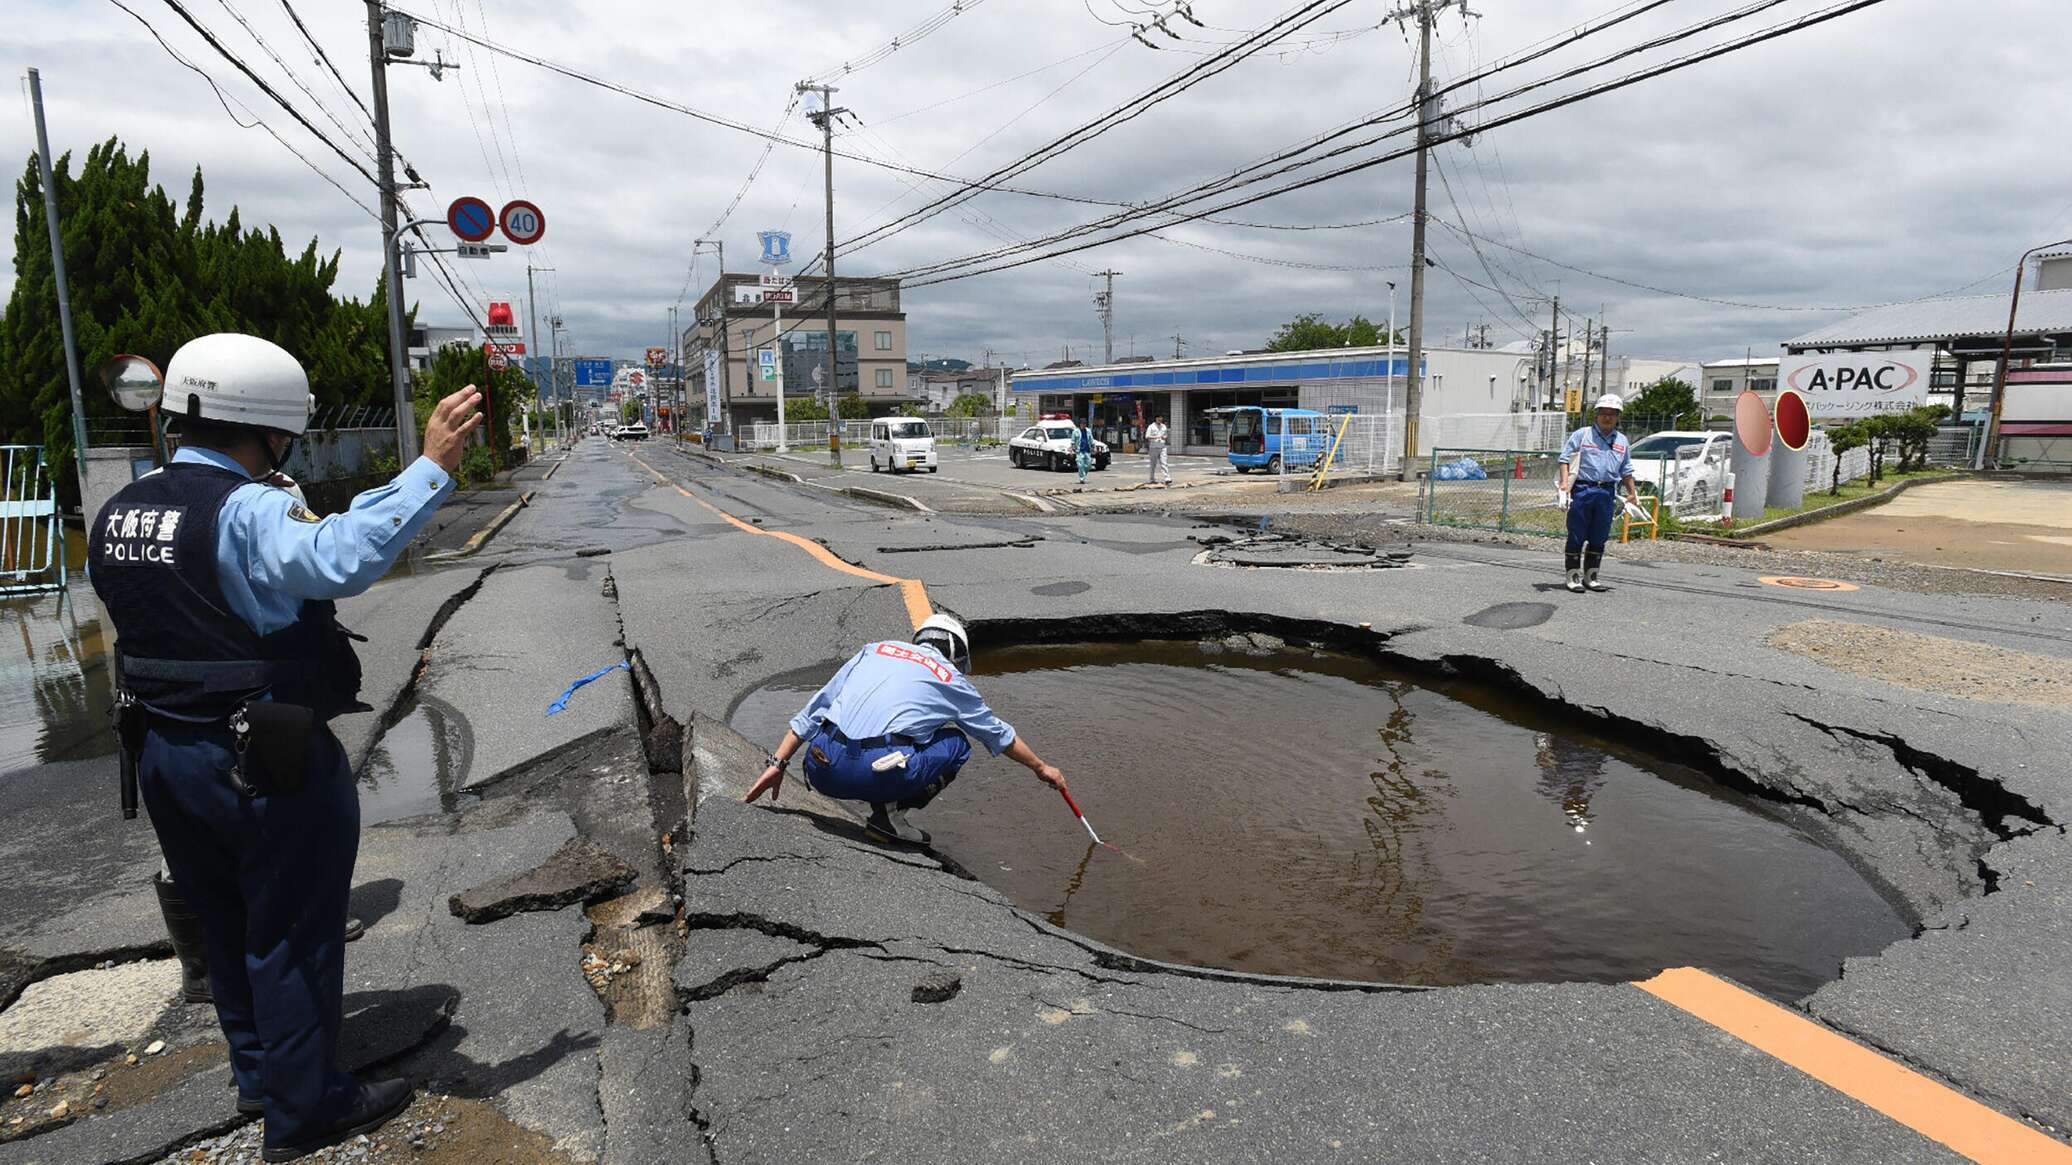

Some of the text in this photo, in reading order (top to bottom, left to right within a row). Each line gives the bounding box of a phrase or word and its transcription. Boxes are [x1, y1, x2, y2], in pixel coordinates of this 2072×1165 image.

[510, 213, 535, 233] 40
[183, 376, 217, 390] 大阪府警
[762, 367, 773, 380] P
[105, 509, 181, 541] 大阪府警
[104, 543, 175, 564] POLICE
